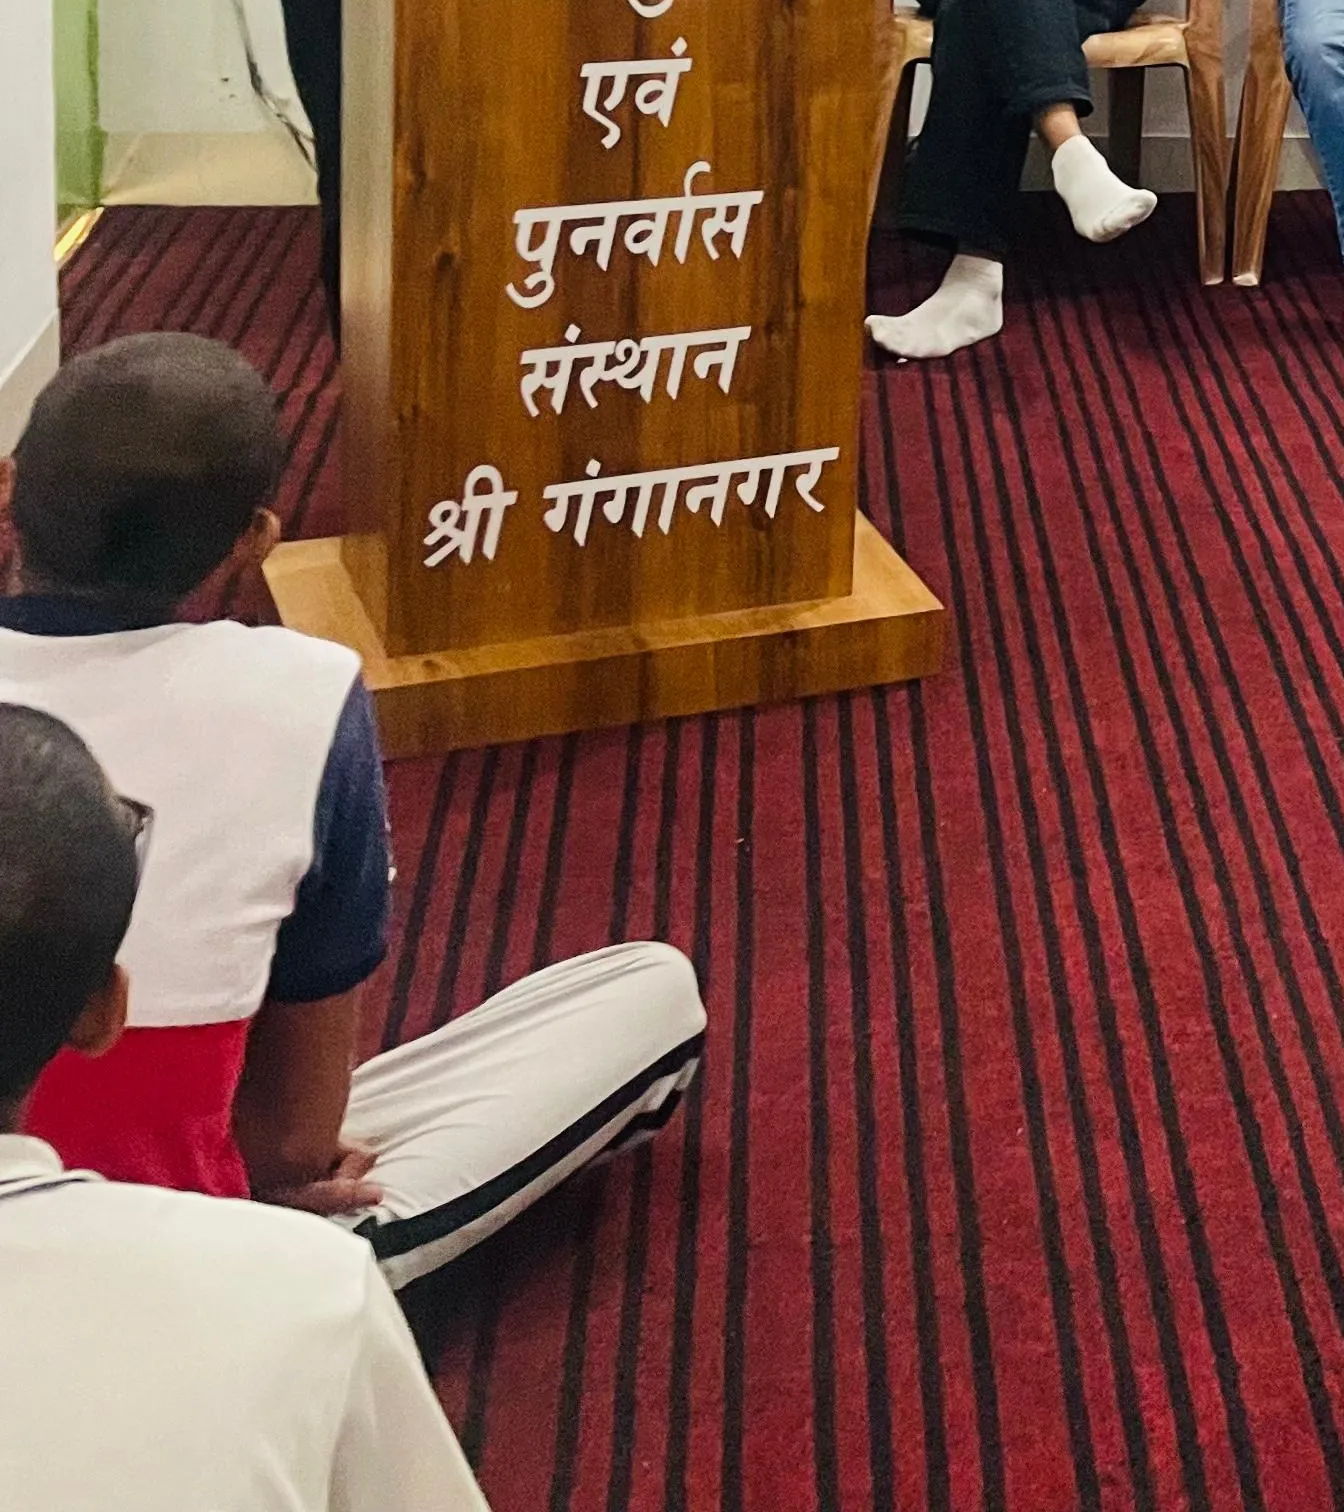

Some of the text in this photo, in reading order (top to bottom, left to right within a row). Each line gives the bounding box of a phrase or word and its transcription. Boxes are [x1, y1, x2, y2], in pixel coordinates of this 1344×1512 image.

[580, 36, 692, 149] एवं
[505, 161, 764, 309] पुनर्वास
[520, 323, 752, 418] संस्थान
[423, 446, 840, 568] श्री गंगानगर
